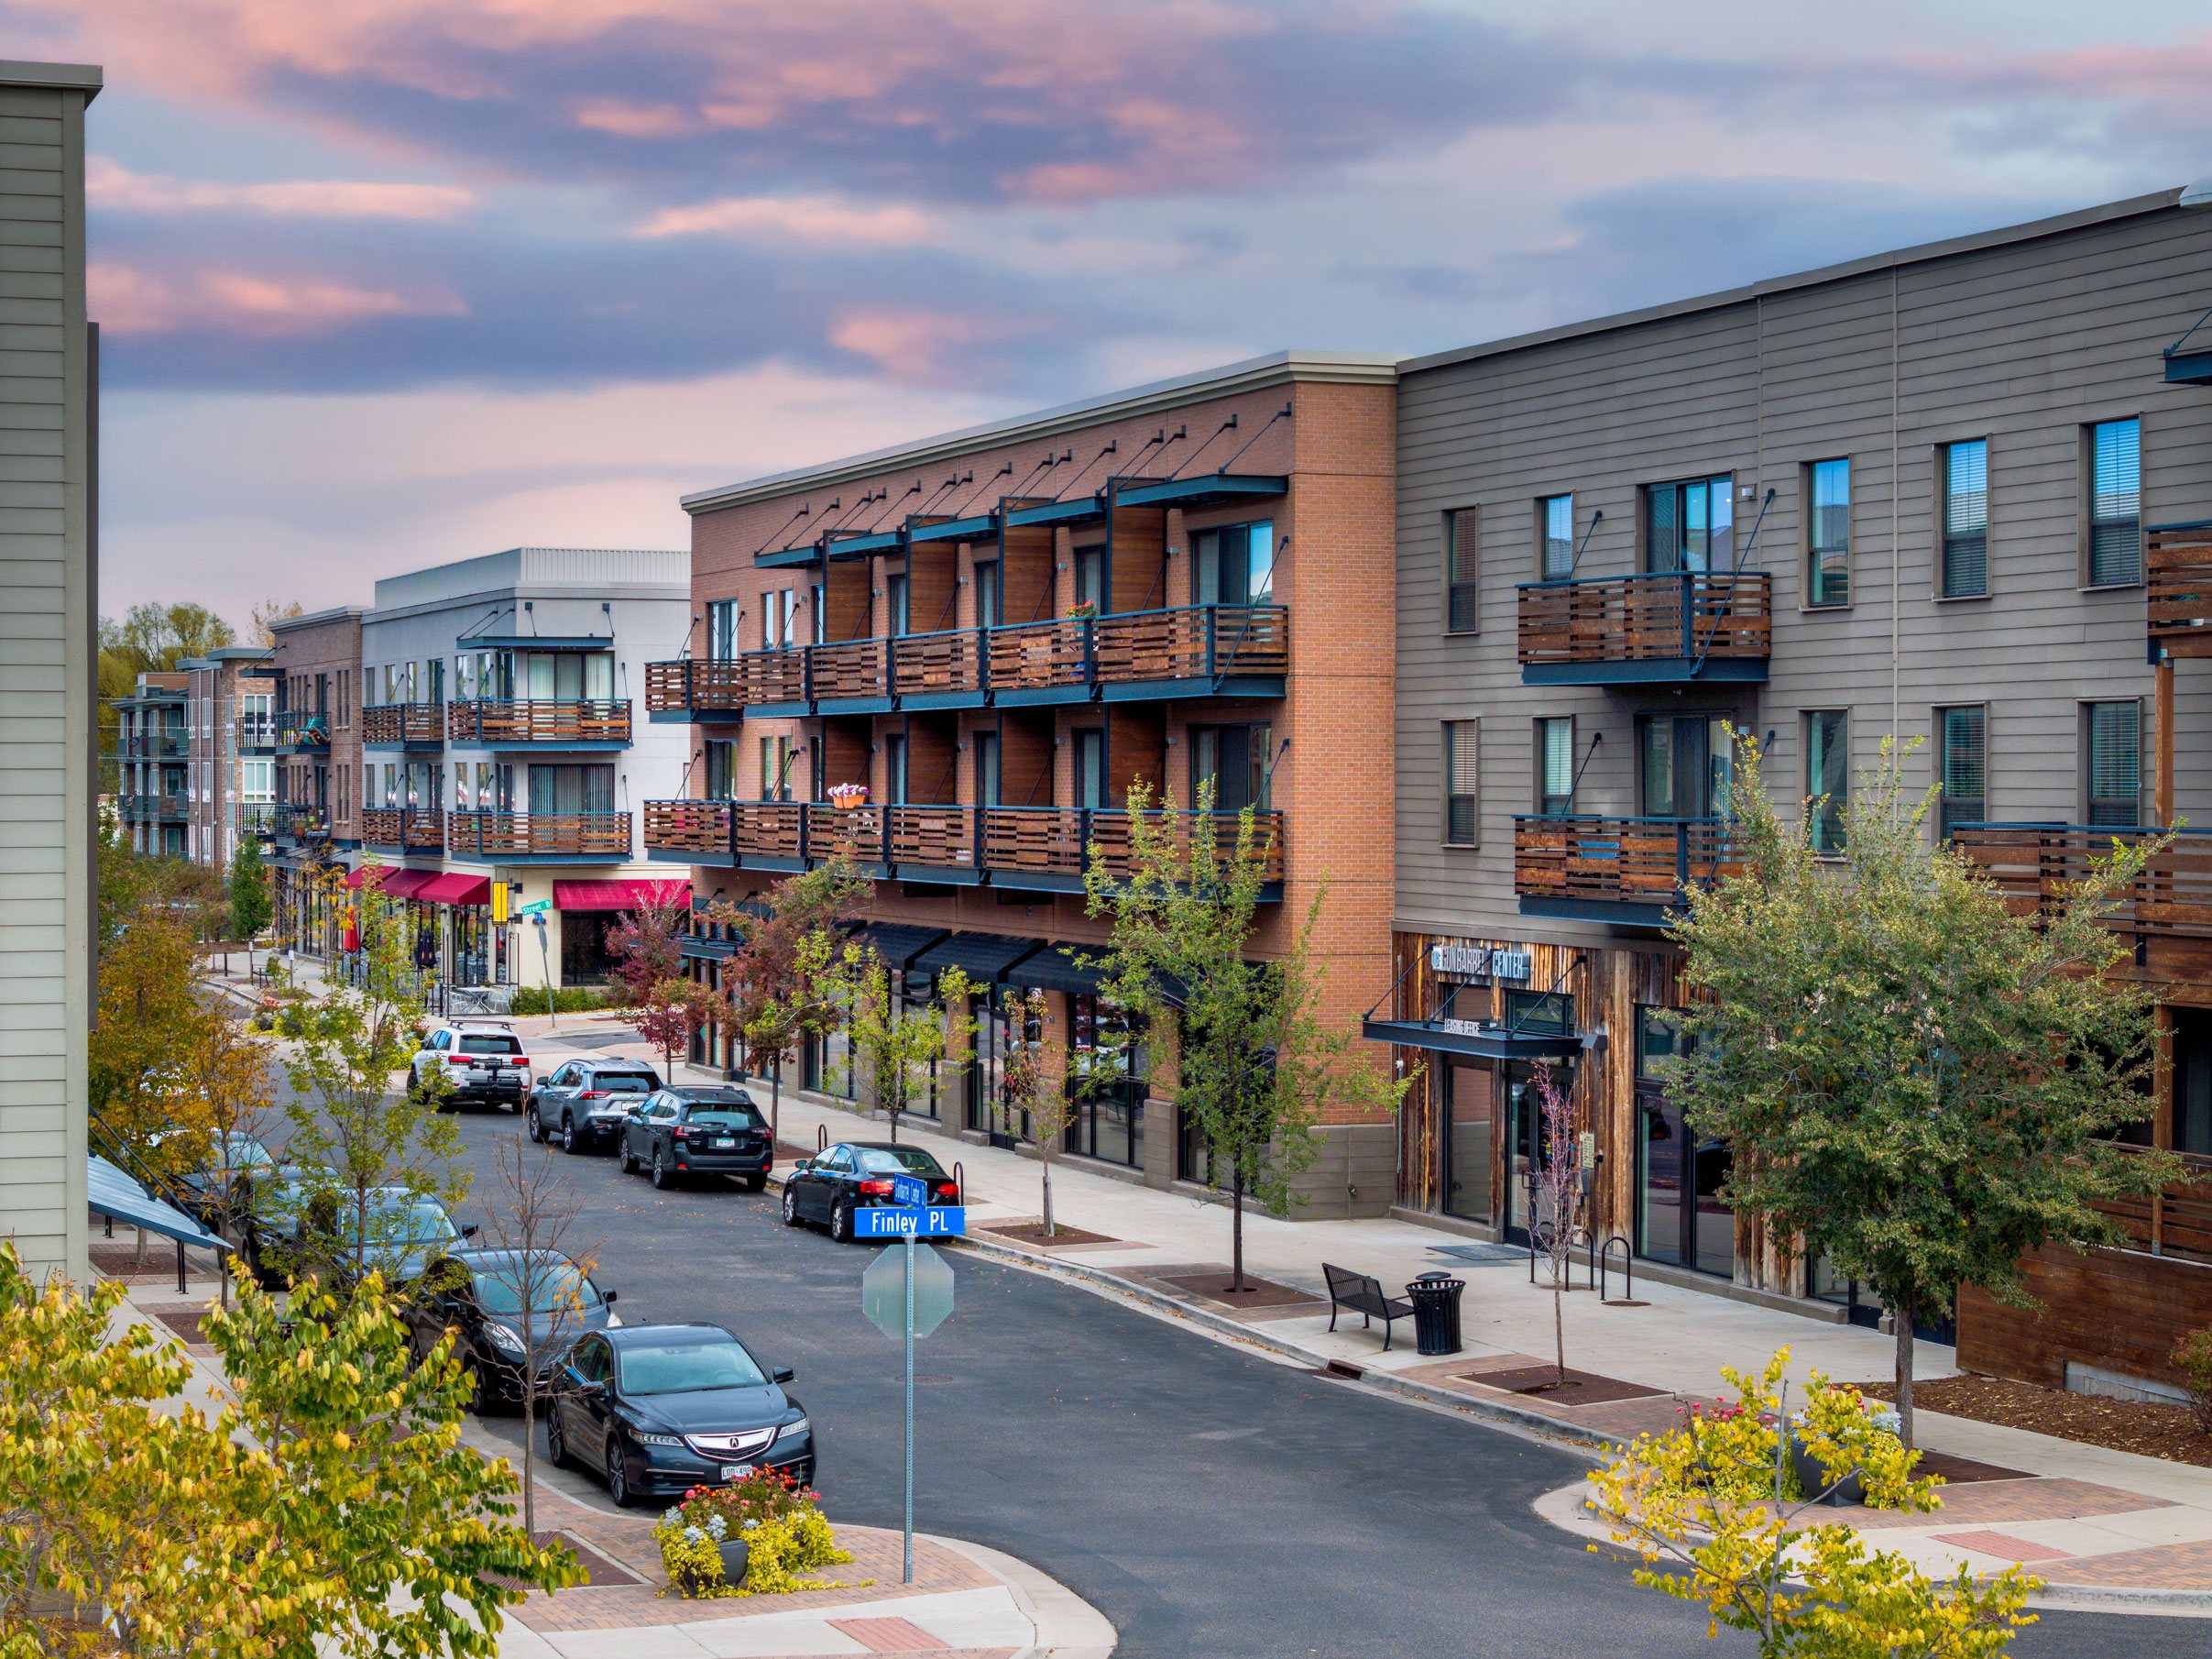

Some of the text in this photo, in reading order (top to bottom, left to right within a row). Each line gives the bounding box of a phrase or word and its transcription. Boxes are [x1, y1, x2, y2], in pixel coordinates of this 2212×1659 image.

[522, 900, 551, 915] Street B
[1442, 947, 1523, 979] GUNBARREL CENTER
[1444, 1018, 1481, 1037] LEASING OFFICE
[871, 1211, 949, 1234] Finley PL
